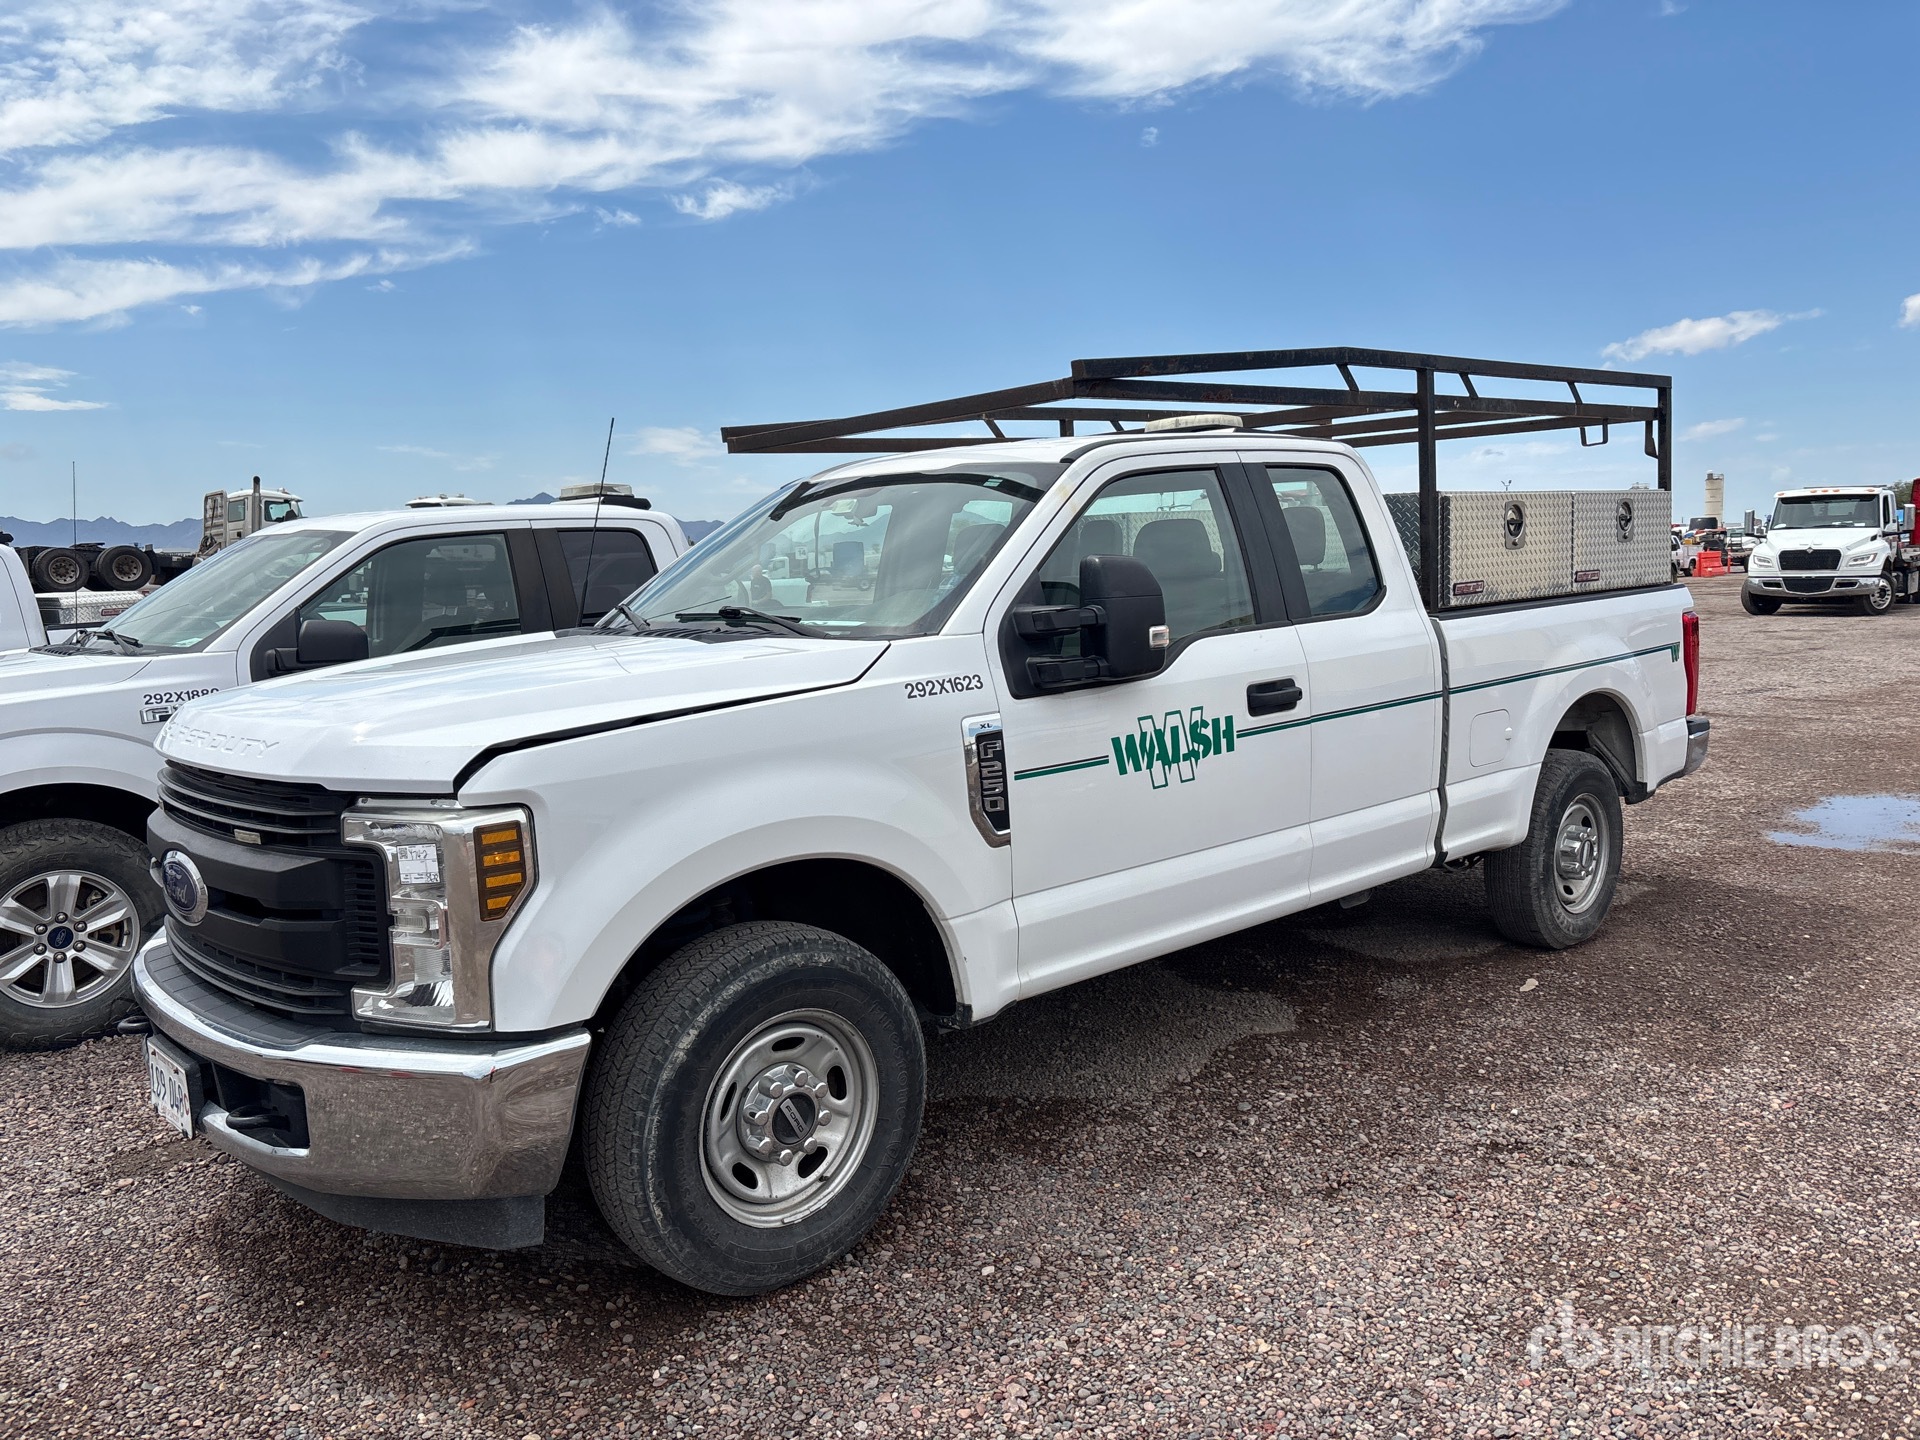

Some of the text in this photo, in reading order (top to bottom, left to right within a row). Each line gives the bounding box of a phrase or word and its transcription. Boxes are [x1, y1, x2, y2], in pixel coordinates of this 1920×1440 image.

[904, 674, 984, 699] 292X1623
[980, 722, 993, 730] XL
[206, 732, 280, 759] DUTY
[1111, 715, 1235, 776] WALSH
[979, 740, 1005, 812] F250
[785, 1105, 804, 1133] FORD
